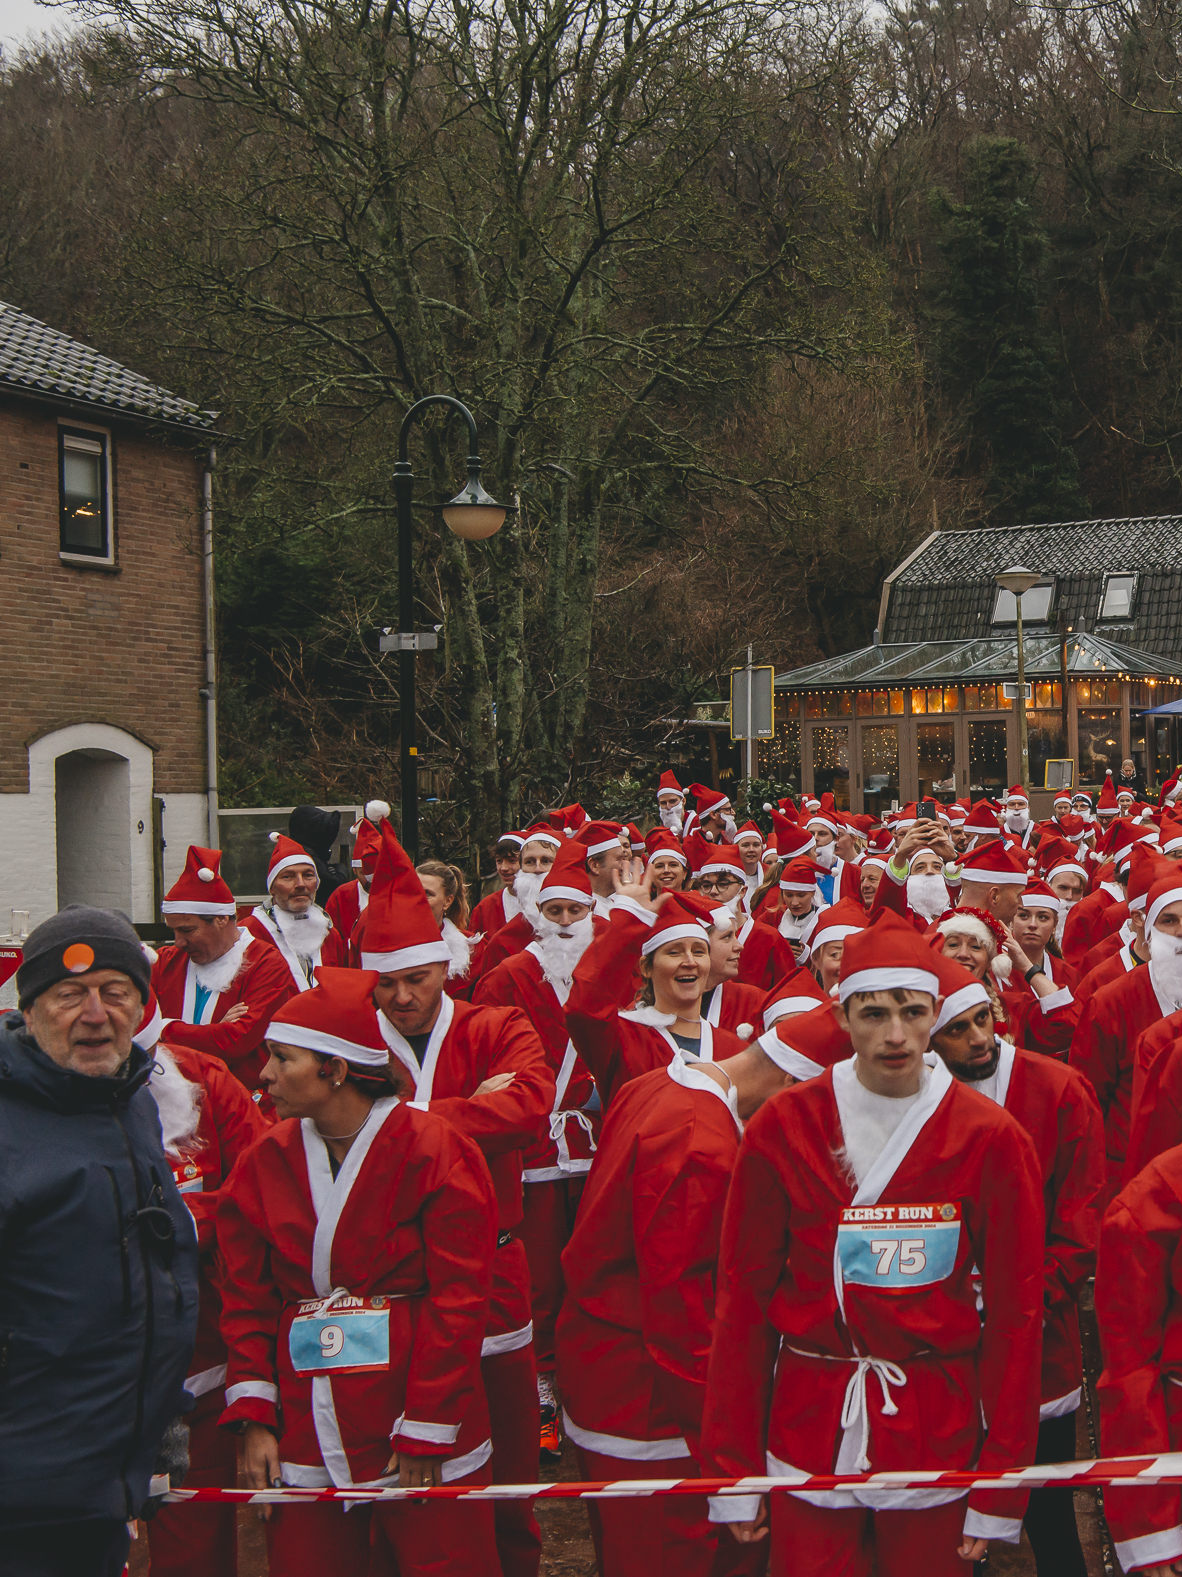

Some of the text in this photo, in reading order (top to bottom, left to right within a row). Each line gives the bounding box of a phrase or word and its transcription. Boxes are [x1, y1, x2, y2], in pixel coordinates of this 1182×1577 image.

[138, 820, 144, 835] 9
[843, 1207, 934, 1221] KERST RUN
[870, 1239, 927, 1276] 75
[333, 1297, 364, 1309] RUN
[320, 1325, 344, 1358] 9
